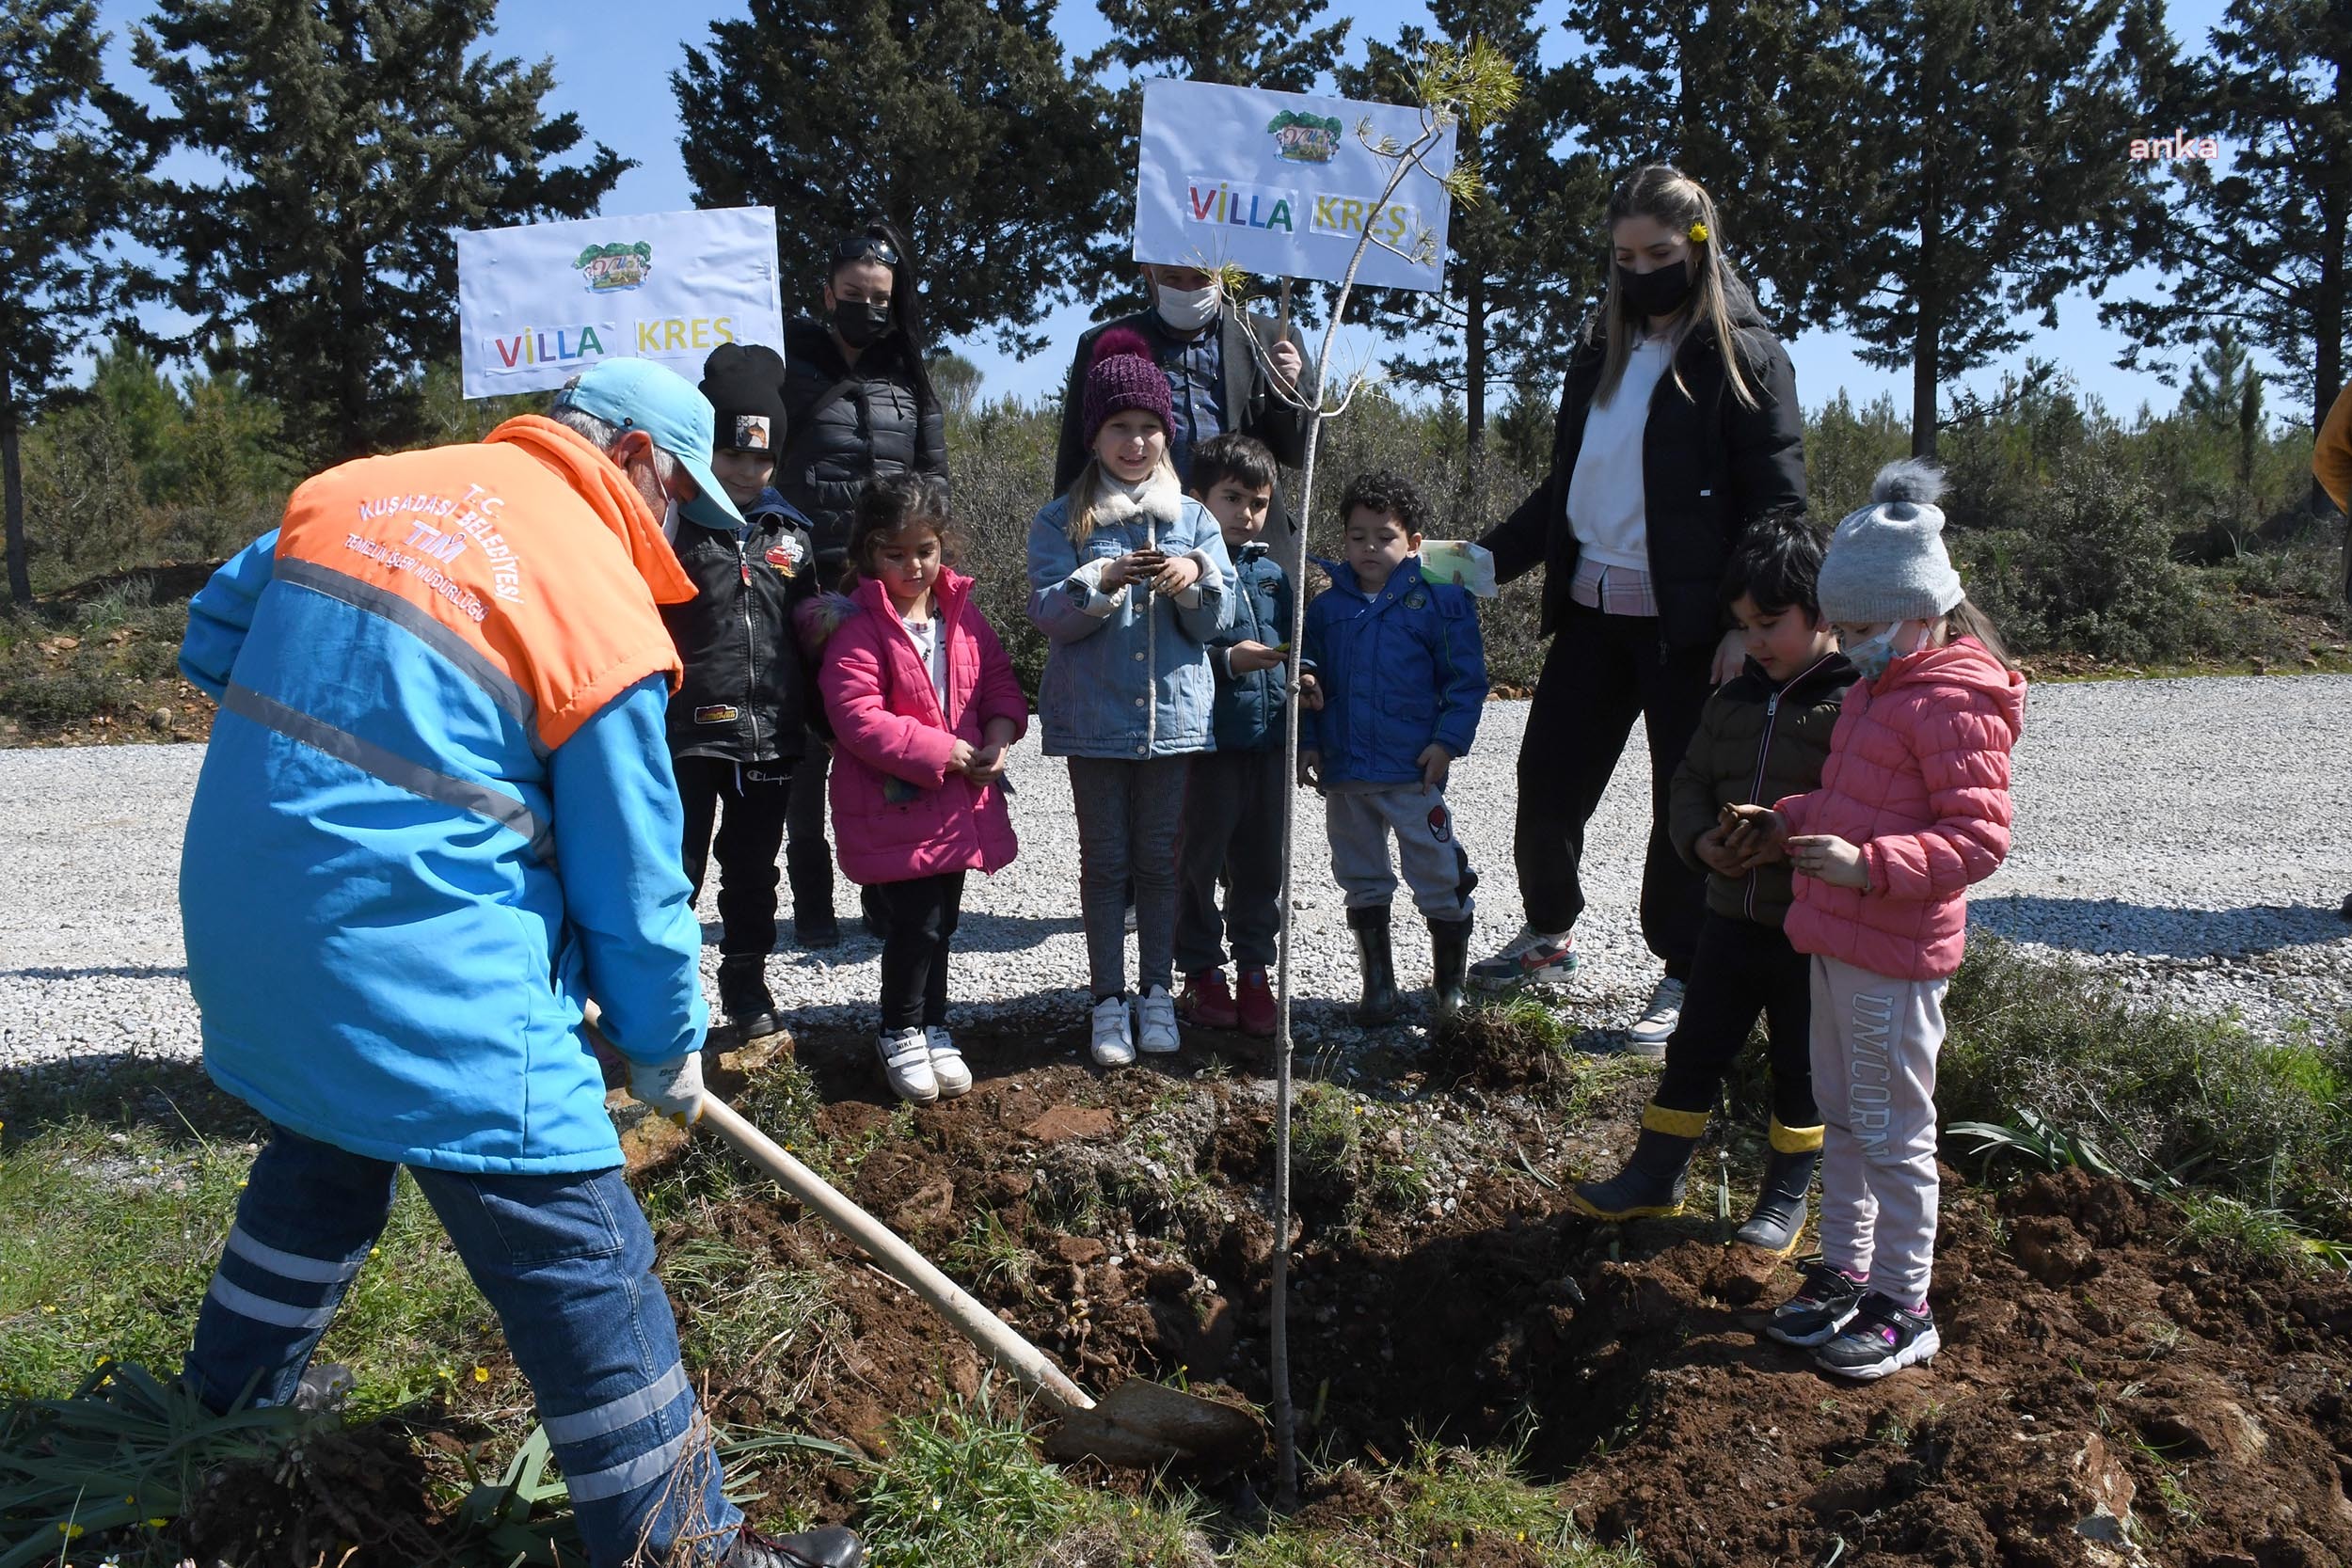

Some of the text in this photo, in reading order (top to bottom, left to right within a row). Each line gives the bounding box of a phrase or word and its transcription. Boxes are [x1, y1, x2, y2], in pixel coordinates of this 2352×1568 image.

[1190, 182, 1294, 232] VİLLA
[495, 326, 604, 368] VİLLA
[359, 494, 459, 521] KUŞADASI
[896, 1039, 913, 1051] NIKE
[1851, 992, 1895, 1158] UNICORN
